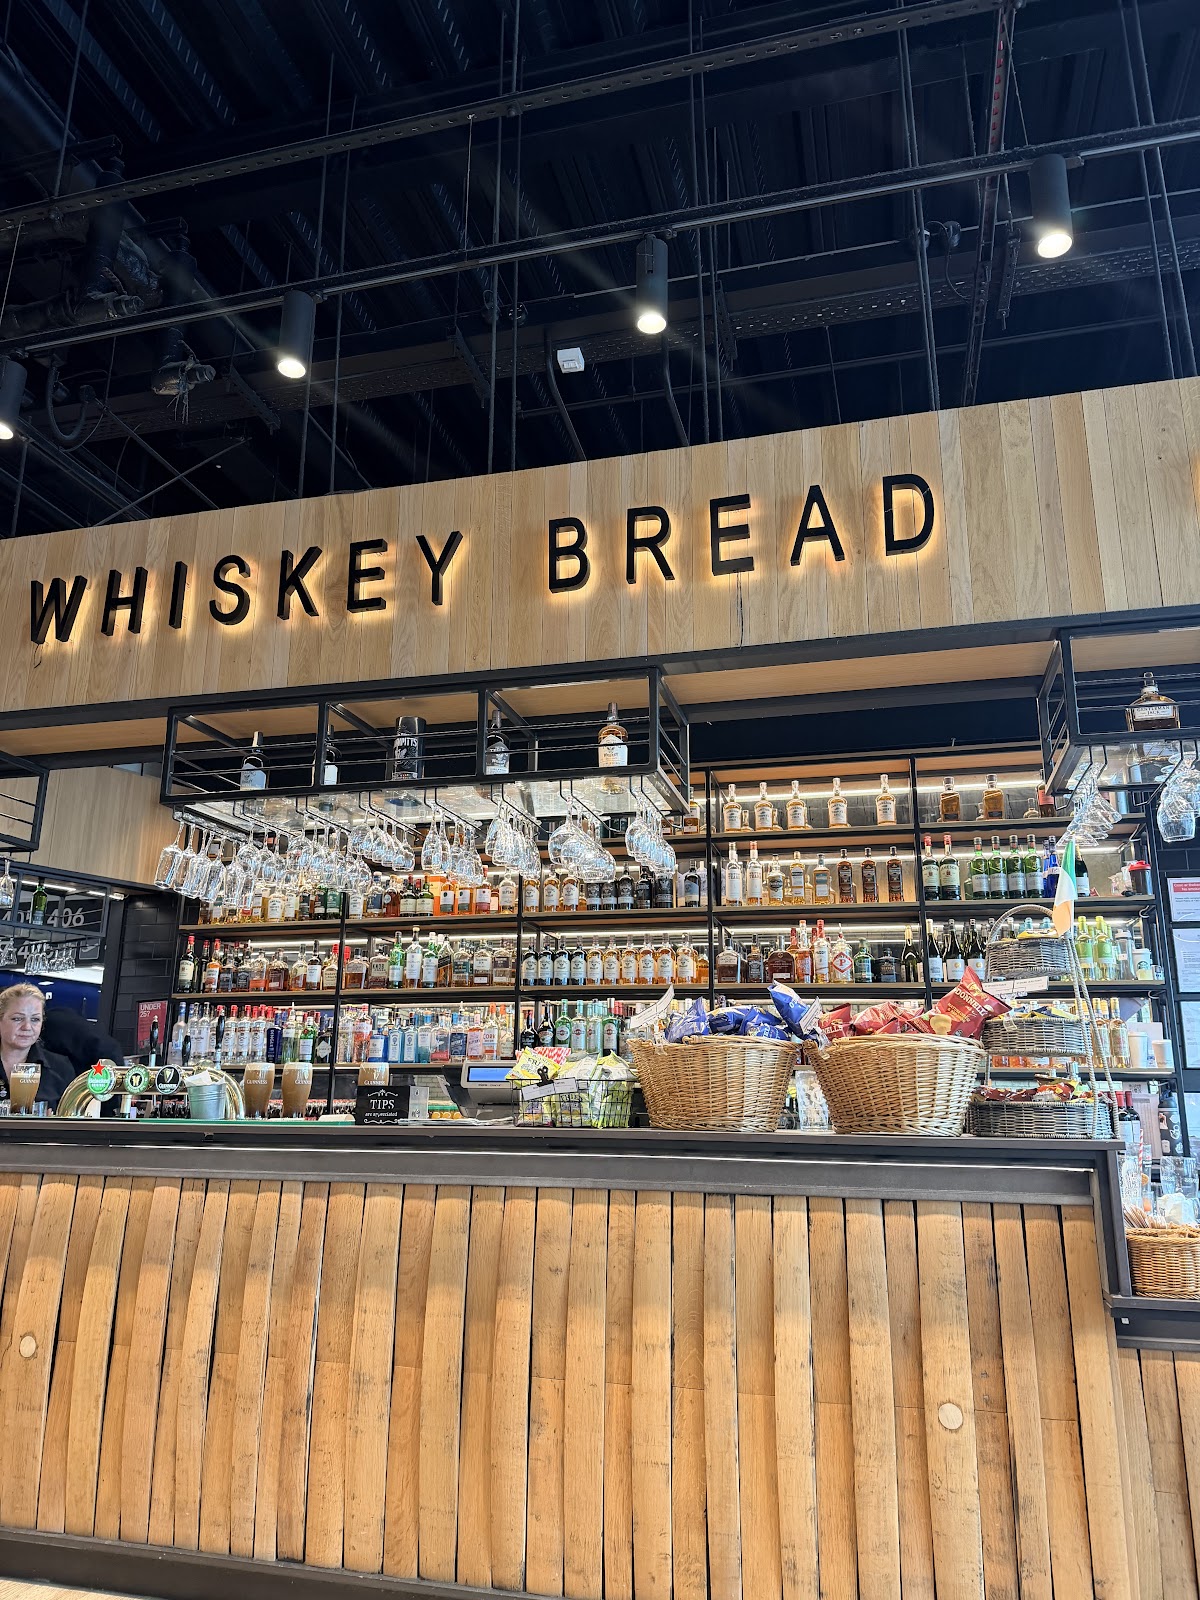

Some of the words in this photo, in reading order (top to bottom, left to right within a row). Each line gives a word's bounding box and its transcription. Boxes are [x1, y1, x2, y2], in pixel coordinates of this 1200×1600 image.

[30, 531, 464, 645] WHISKEY
[547, 473, 936, 595] BREAD
[139, 1003, 162, 1011] UNDER
[139, 1010, 151, 1018] 25?
[370, 1099, 395, 1110] TIPS
